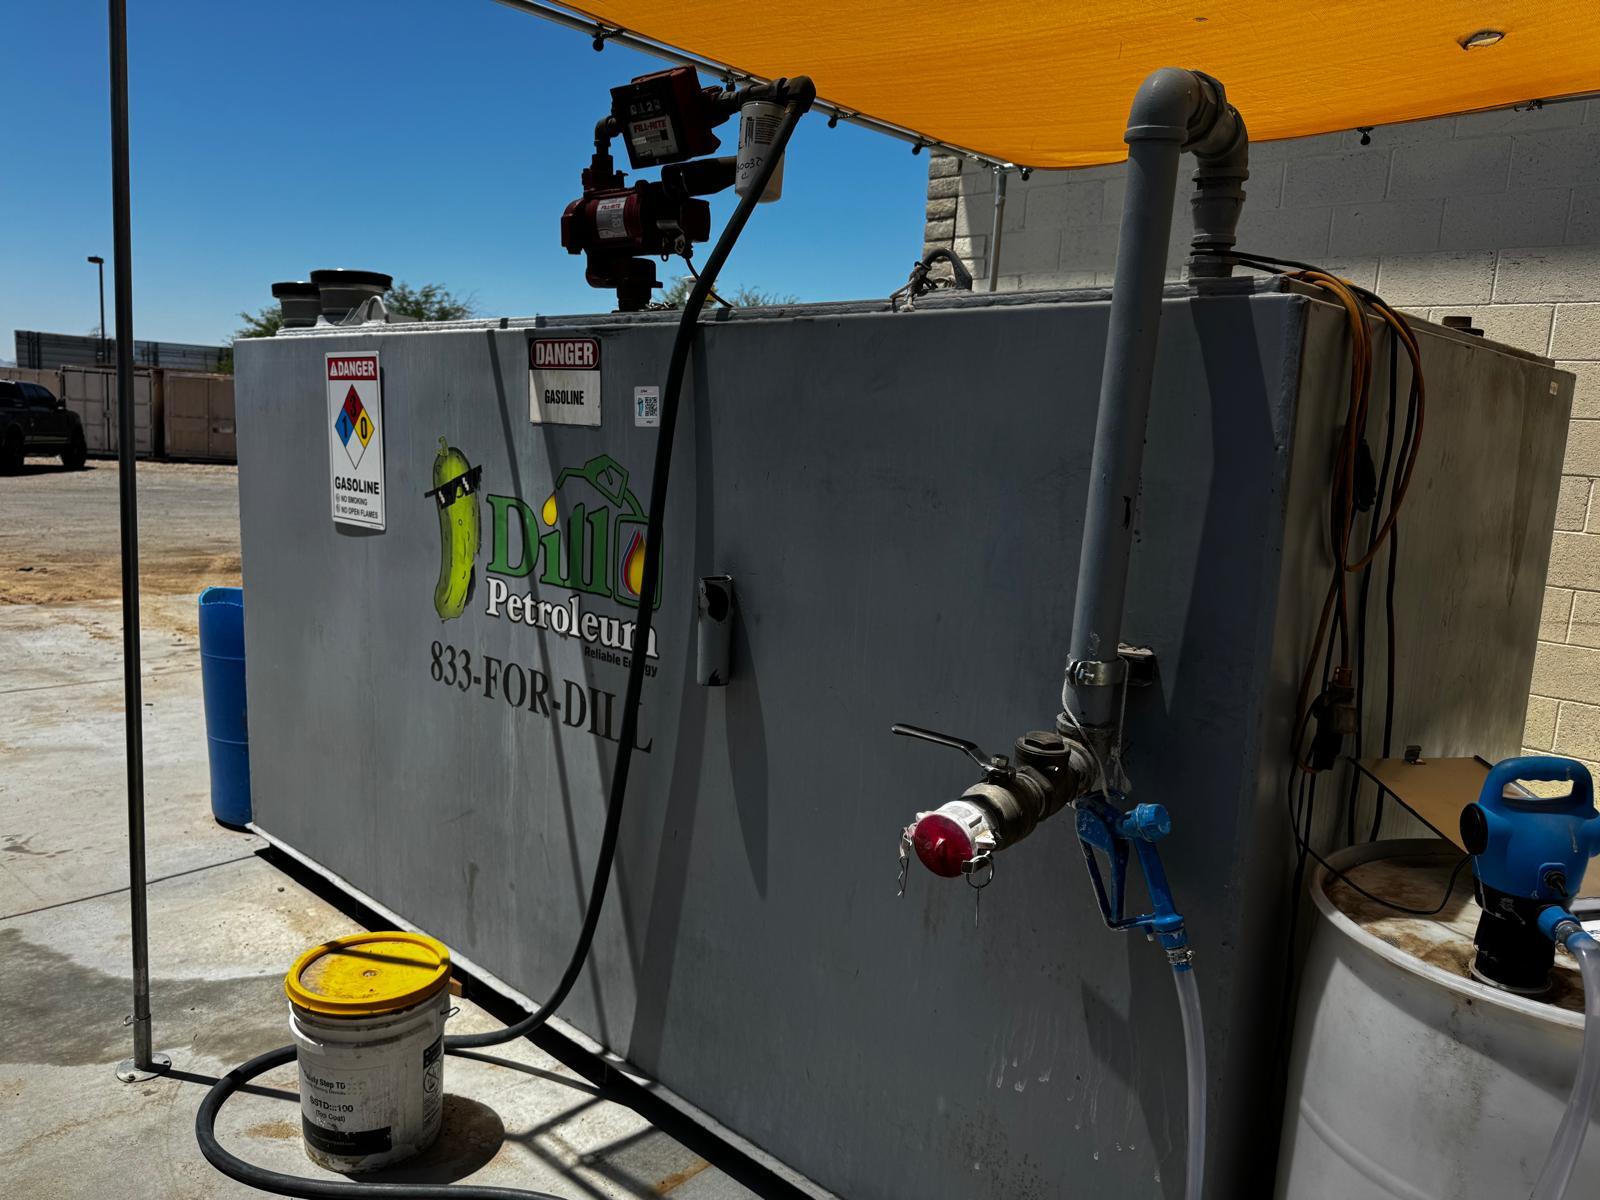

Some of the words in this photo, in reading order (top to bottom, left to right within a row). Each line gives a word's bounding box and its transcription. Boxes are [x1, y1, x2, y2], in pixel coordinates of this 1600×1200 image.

[633, 120, 667, 134] FILL-RITE
[535, 342, 594, 366] DANGER
[337, 360, 375, 377] DANGER
[350, 395, 357, 418] 3
[544, 389, 585, 406] GASOLINE
[342, 417, 348, 439] 1
[360, 417, 368, 440] 0
[335, 476, 380, 495] GASOLINE
[341, 495, 347, 503] NO
[348, 496, 368, 506] SMOKING
[341, 506, 348, 514] NO
[348, 507, 360, 516] OPEN
[360, 508, 379, 519] FLAMES
[486, 491, 612, 599] Dill
[485, 577, 660, 659] Petroleum
[585, 646, 621, 666] Reliable
[623, 657, 658, 677] Egy
[319, 1078, 335, 1090] Step
[336, 1081, 346, 1090] TD
[328, 1113, 346, 1123] Coat)
